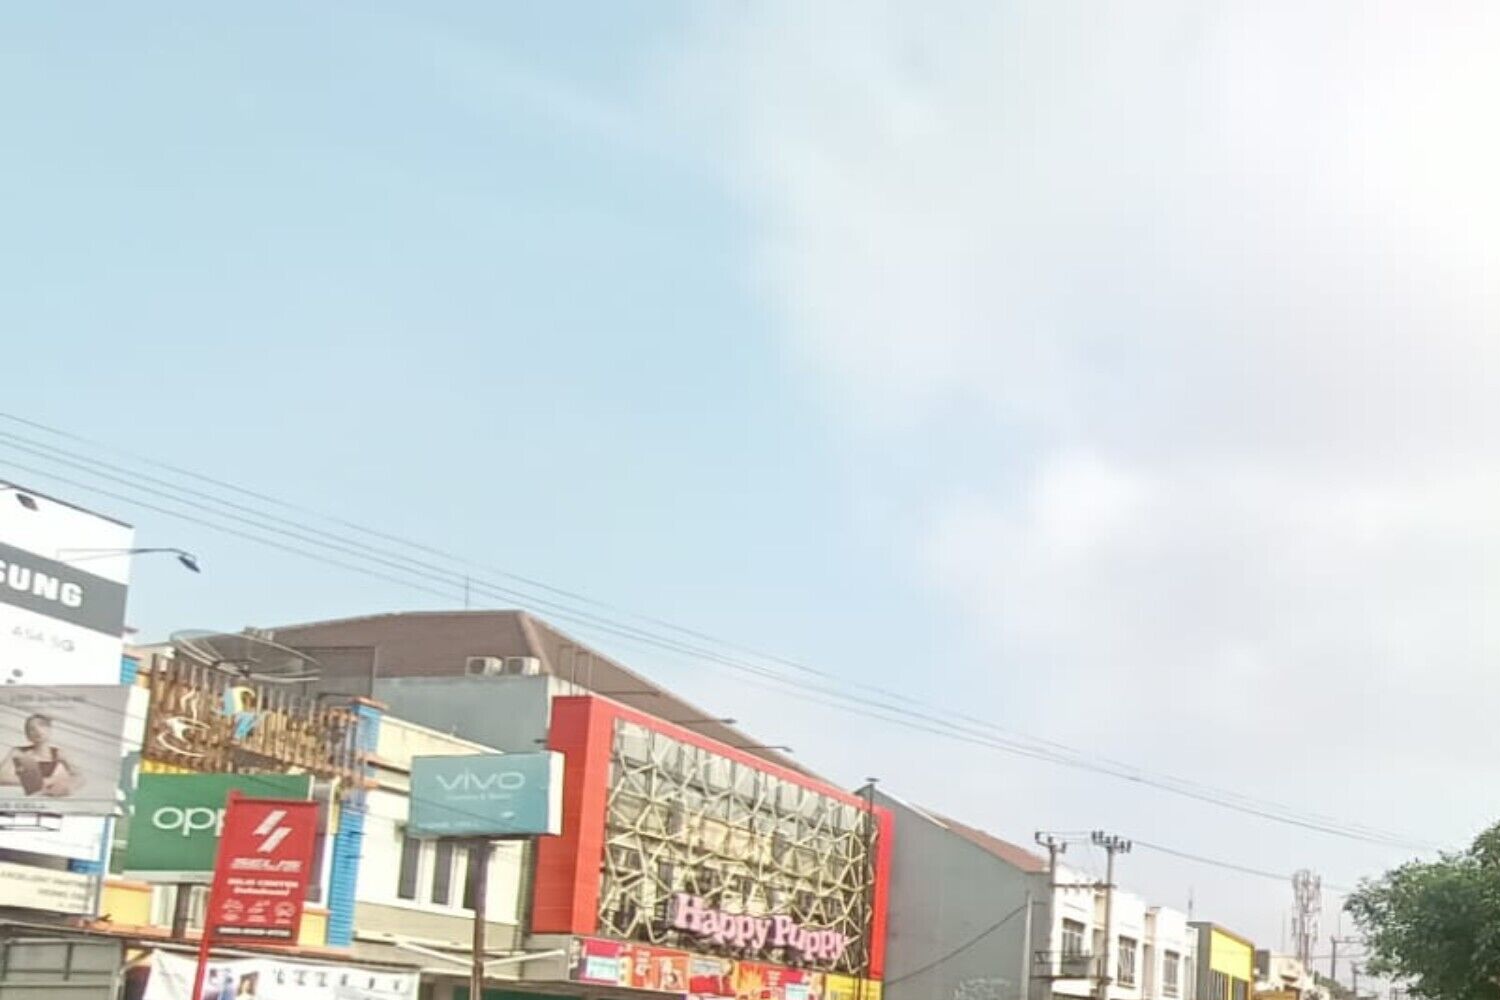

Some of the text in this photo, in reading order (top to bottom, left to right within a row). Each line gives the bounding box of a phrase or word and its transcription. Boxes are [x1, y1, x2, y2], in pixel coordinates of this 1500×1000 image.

[436, 767, 526, 791] vivo
[673, 892, 846, 961] Happy Puppy
